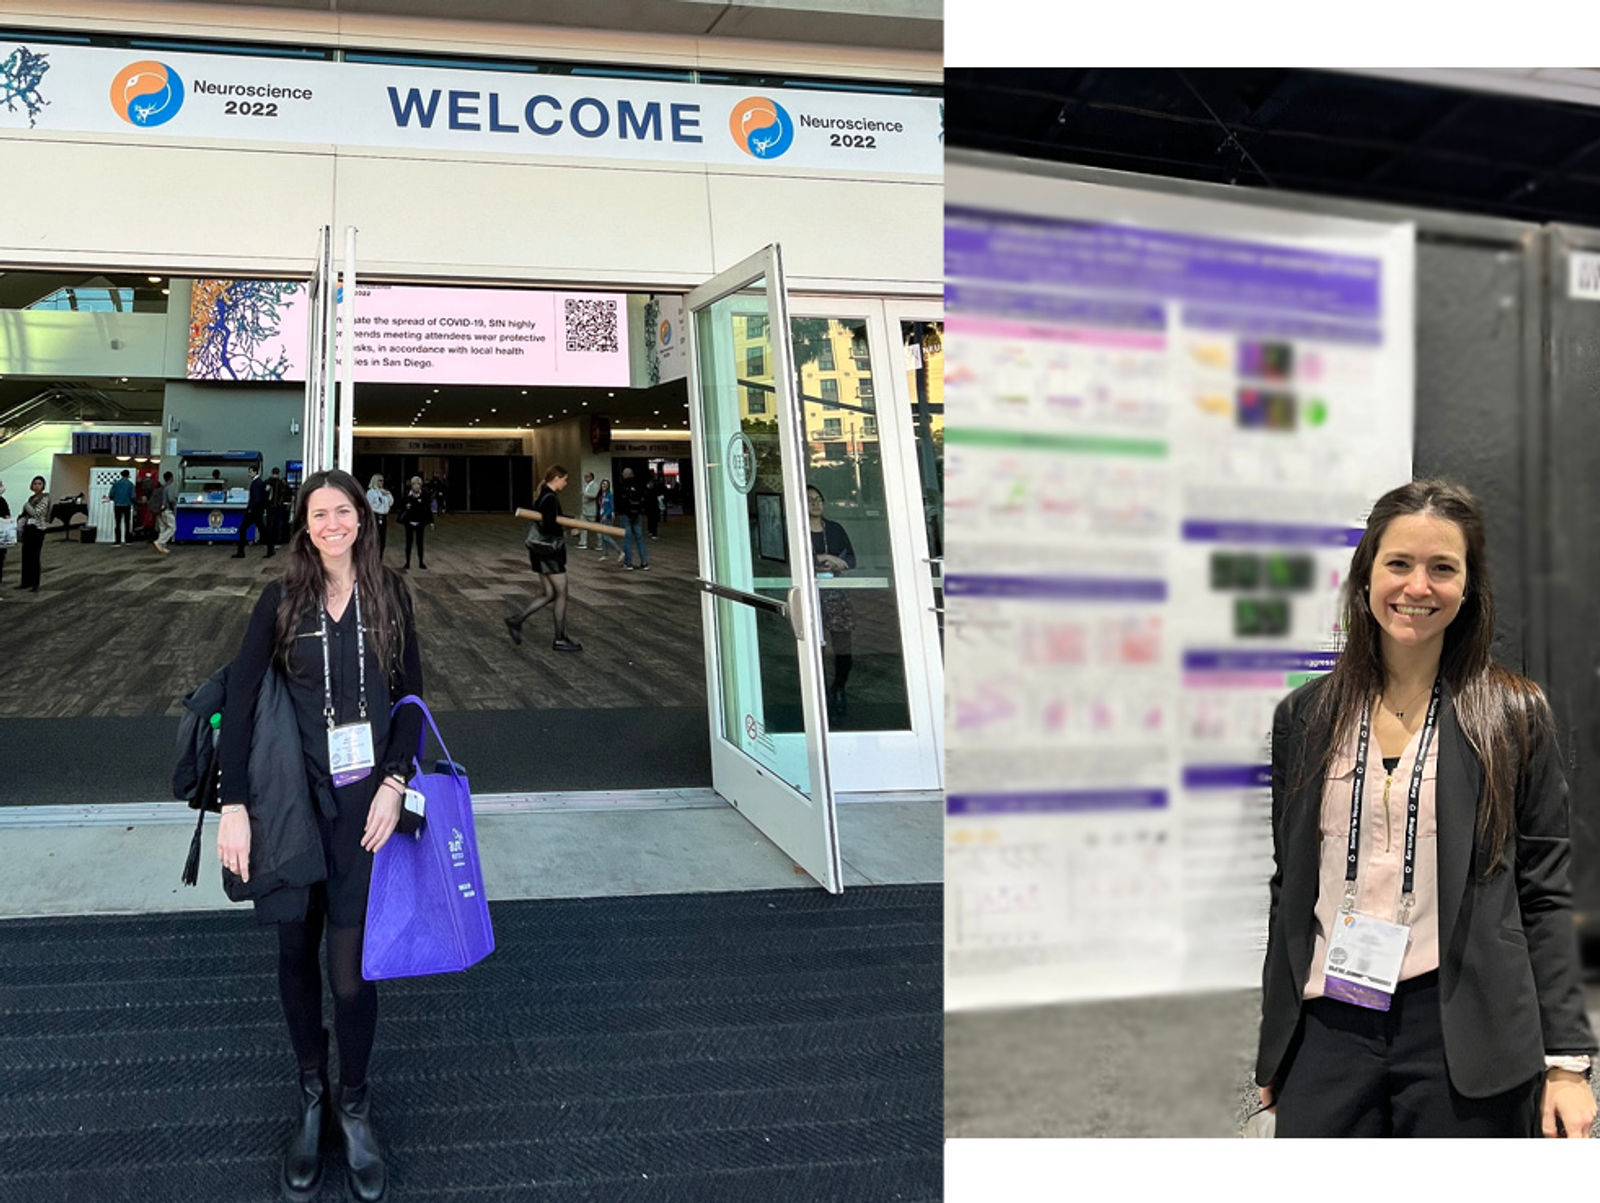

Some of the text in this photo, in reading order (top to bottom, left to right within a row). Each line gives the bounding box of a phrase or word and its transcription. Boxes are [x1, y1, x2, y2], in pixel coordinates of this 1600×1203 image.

[193, 80, 313, 100] Neuroscience
[225, 101, 278, 117] 2022
[387, 86, 704, 143] WELCOME
[800, 114, 904, 133] Neuroscience
[830, 134, 877, 149] 2022
[373, 316, 389, 325] the
[392, 317, 424, 327] spread
[427, 317, 437, 325] of
[439, 317, 486, 328] COVID-19,
[489, 319, 505, 327] SfN
[508, 320, 536, 330] highly
[383, 331, 422, 341] meeting
[424, 332, 472, 341] attendees
[499, 334, 546, 343] protective
[378, 344, 387, 352] in
[389, 345, 445, 354] accordance
[448, 346, 468, 354] with
[471, 346, 493, 355] local
[495, 347, 524, 355] health
[382, 358, 401, 366] San
[403, 359, 434, 369] Diego.
[1352, 778, 1361, 818] Neuroscience
[1349, 827, 1357, 849] Society
